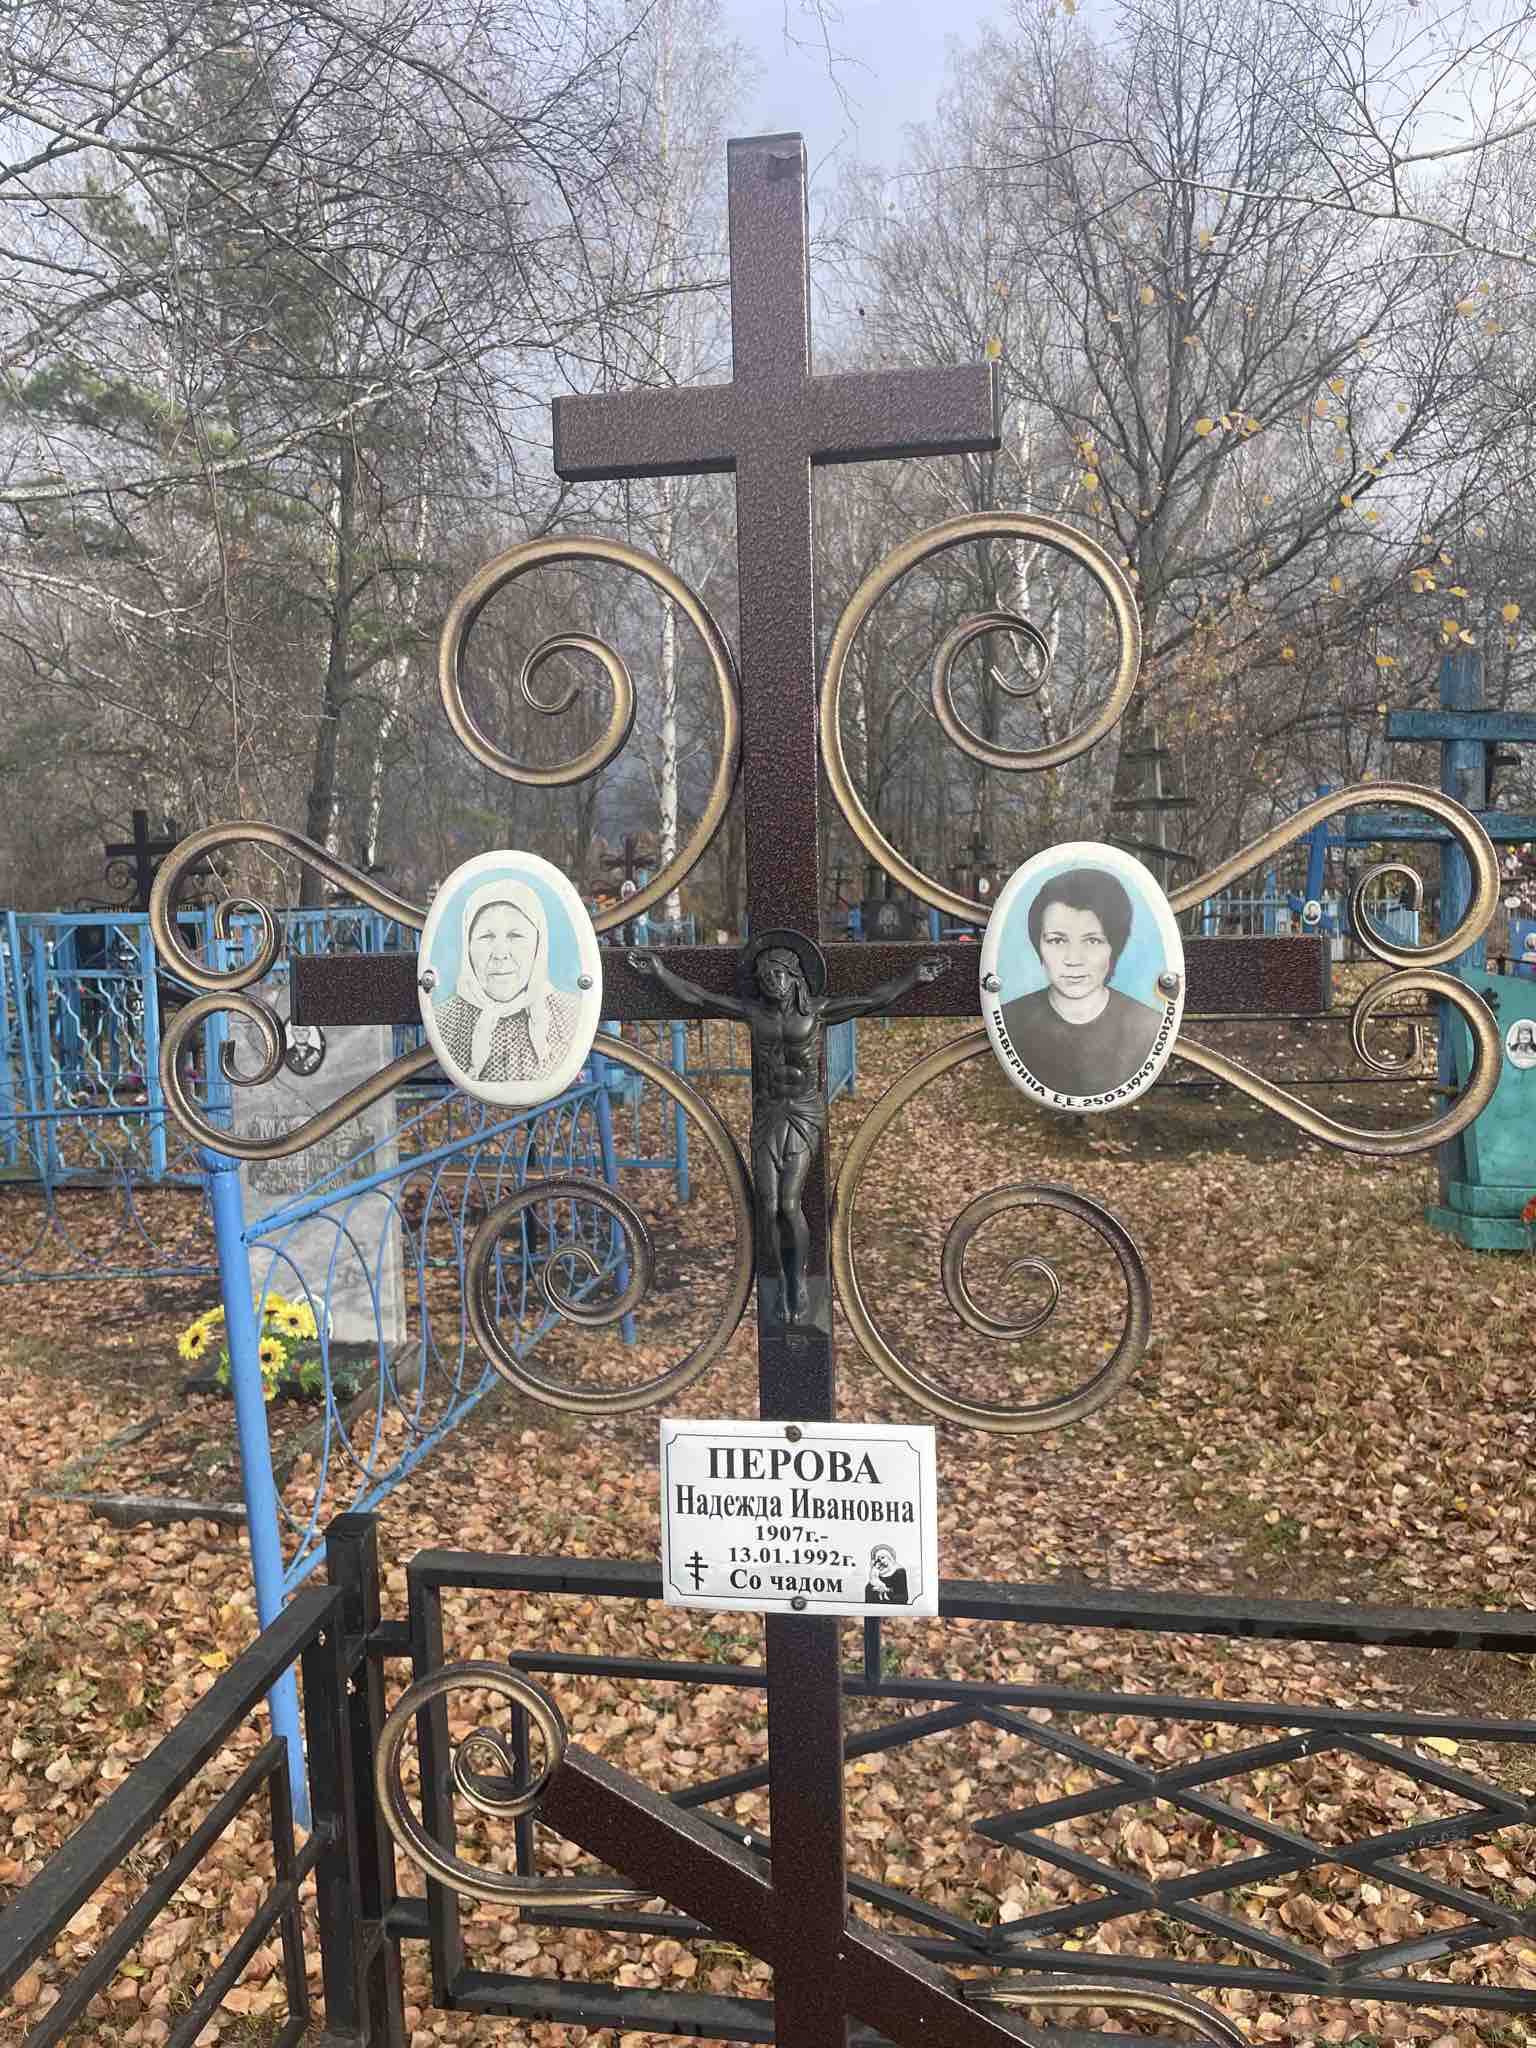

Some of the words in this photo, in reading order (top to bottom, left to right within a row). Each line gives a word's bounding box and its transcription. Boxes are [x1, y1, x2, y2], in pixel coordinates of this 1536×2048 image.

[706, 1447, 881, 1484] ПЕРОВА
[676, 1484, 783, 1520] Надежда
[790, 1488, 914, 1523] Ивановна
[729, 1547, 856, 1567] 13.01.1992г.
[730, 1569, 761, 1590] Со
[770, 1574, 843, 1593] чадом
